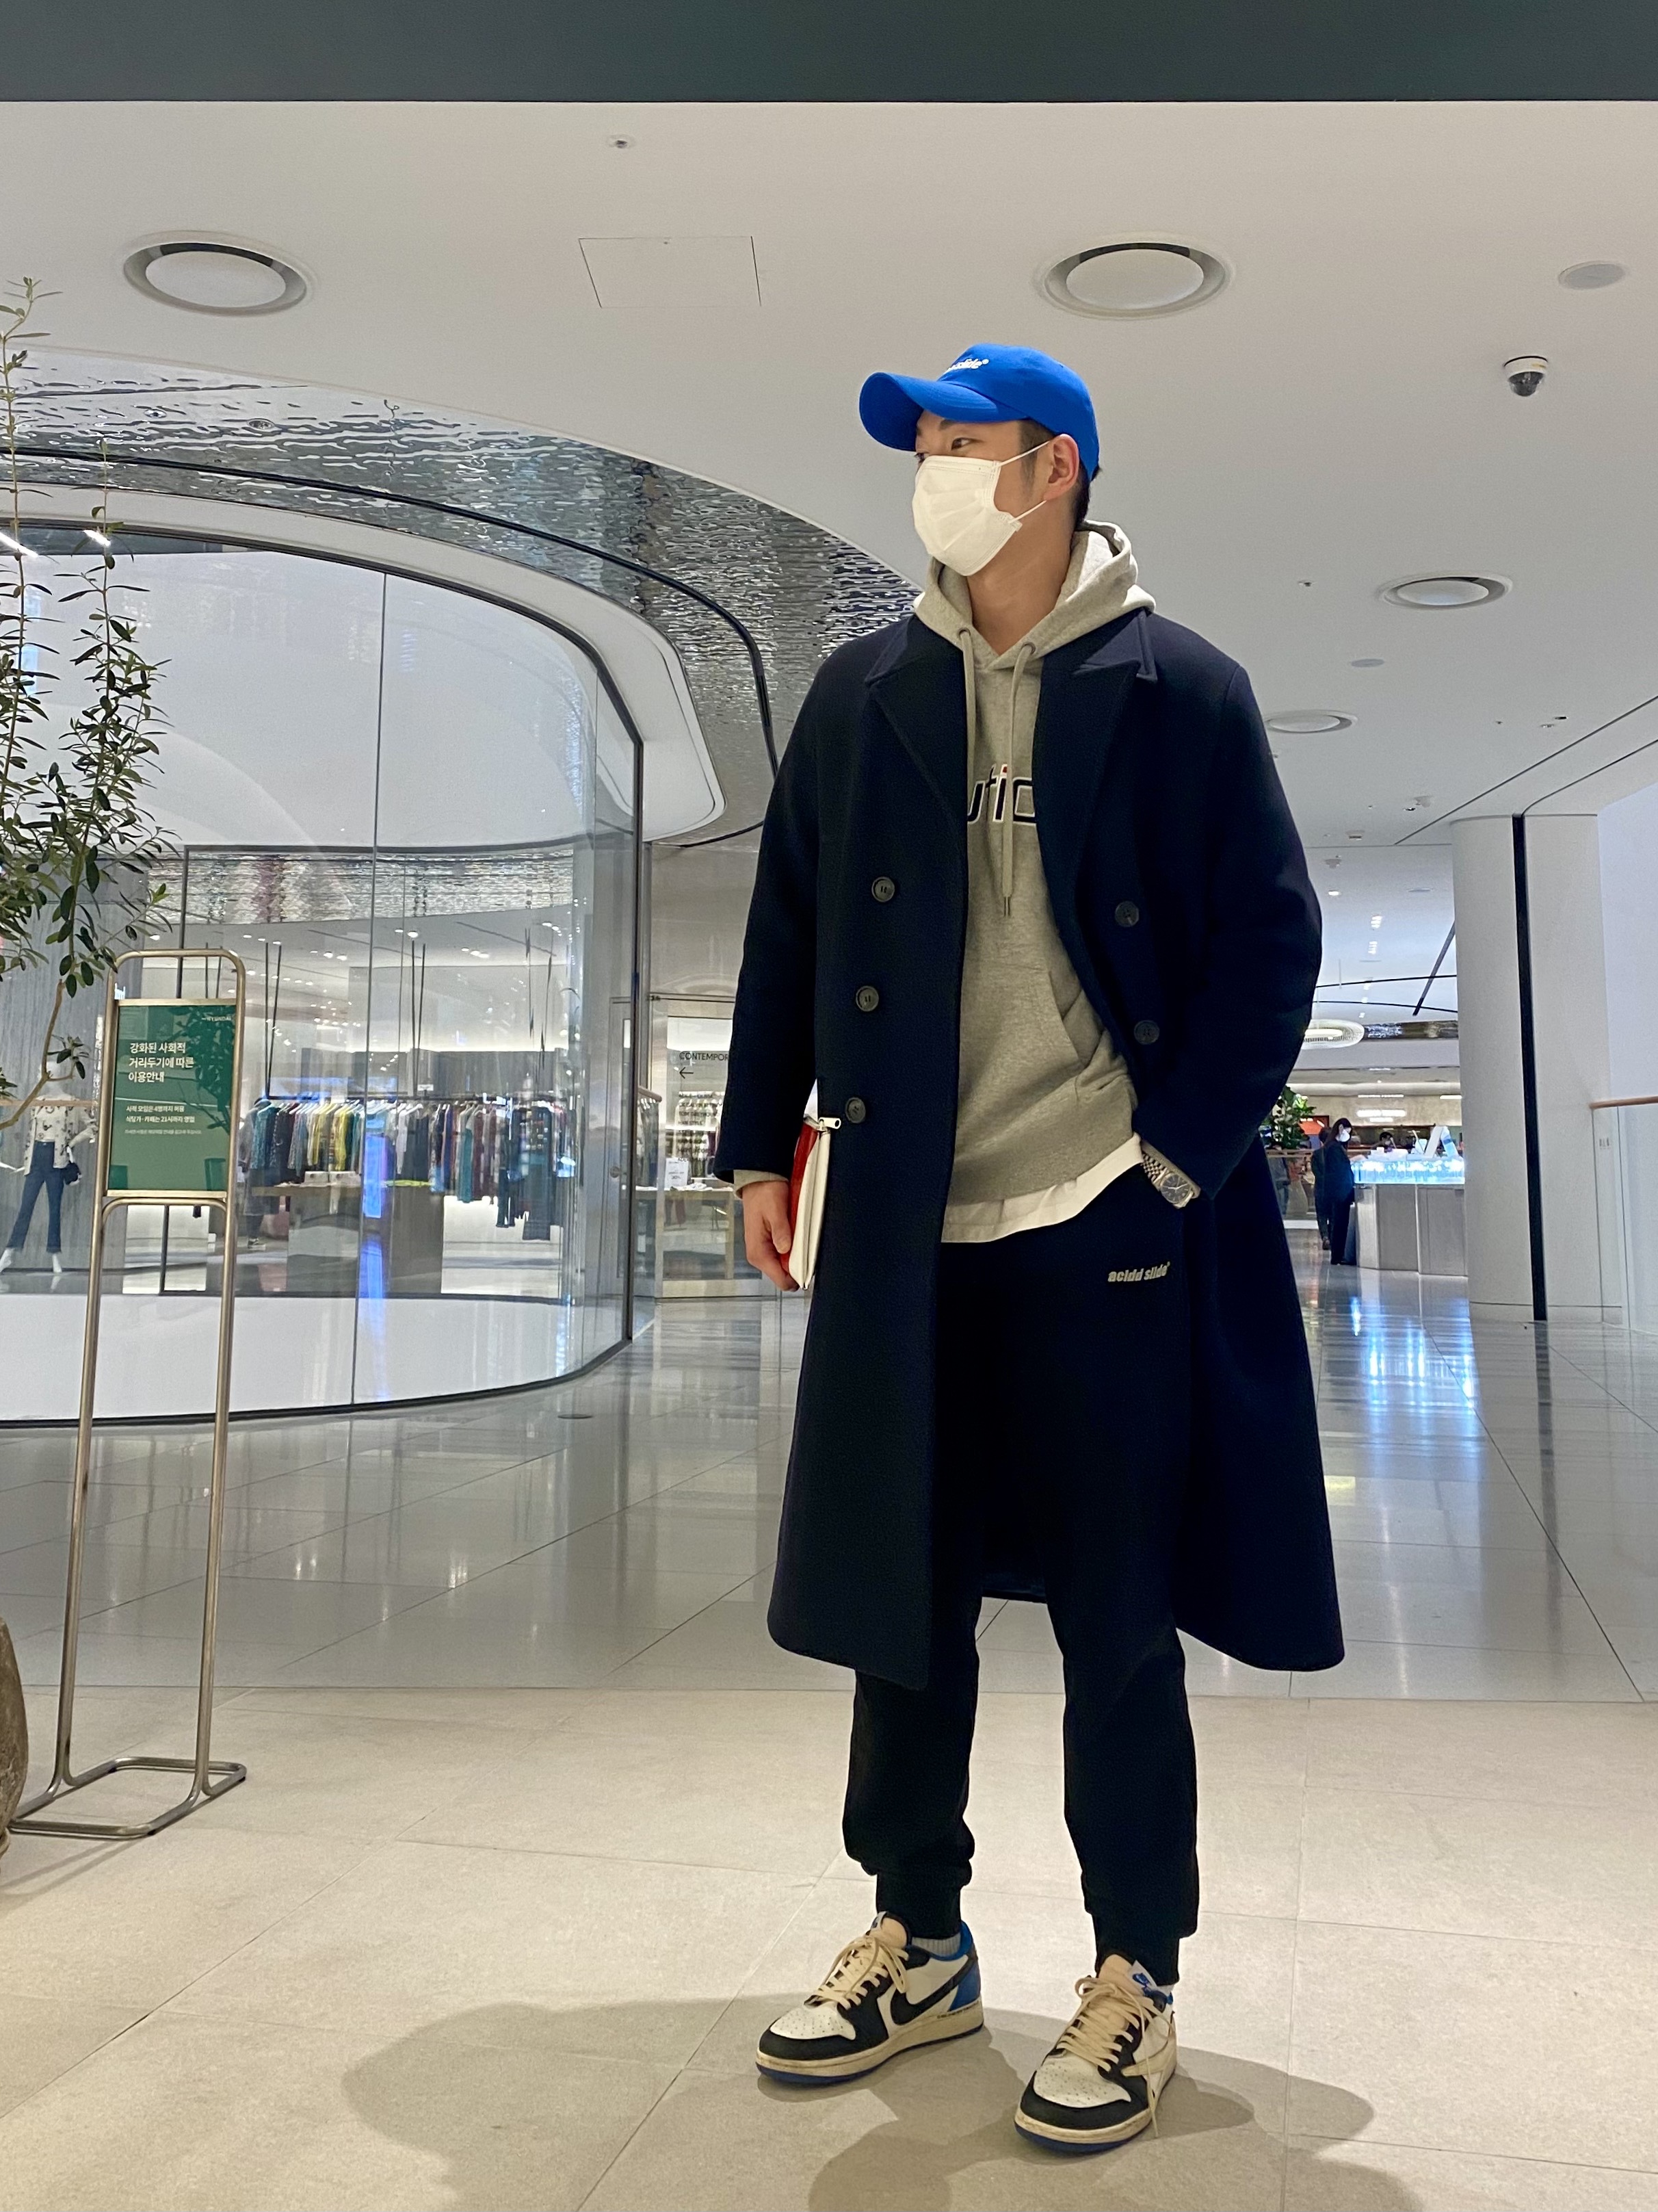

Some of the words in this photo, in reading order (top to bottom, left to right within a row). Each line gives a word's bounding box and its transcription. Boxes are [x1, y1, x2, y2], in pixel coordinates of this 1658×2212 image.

[130, 1043, 157, 1054] 강화된
[159, 1043, 186, 1054] 사회적
[129, 1057, 174, 1068] 거리두기에
[176, 1057, 194, 1068] 따른
[128, 1071, 164, 1082] 이용안내
